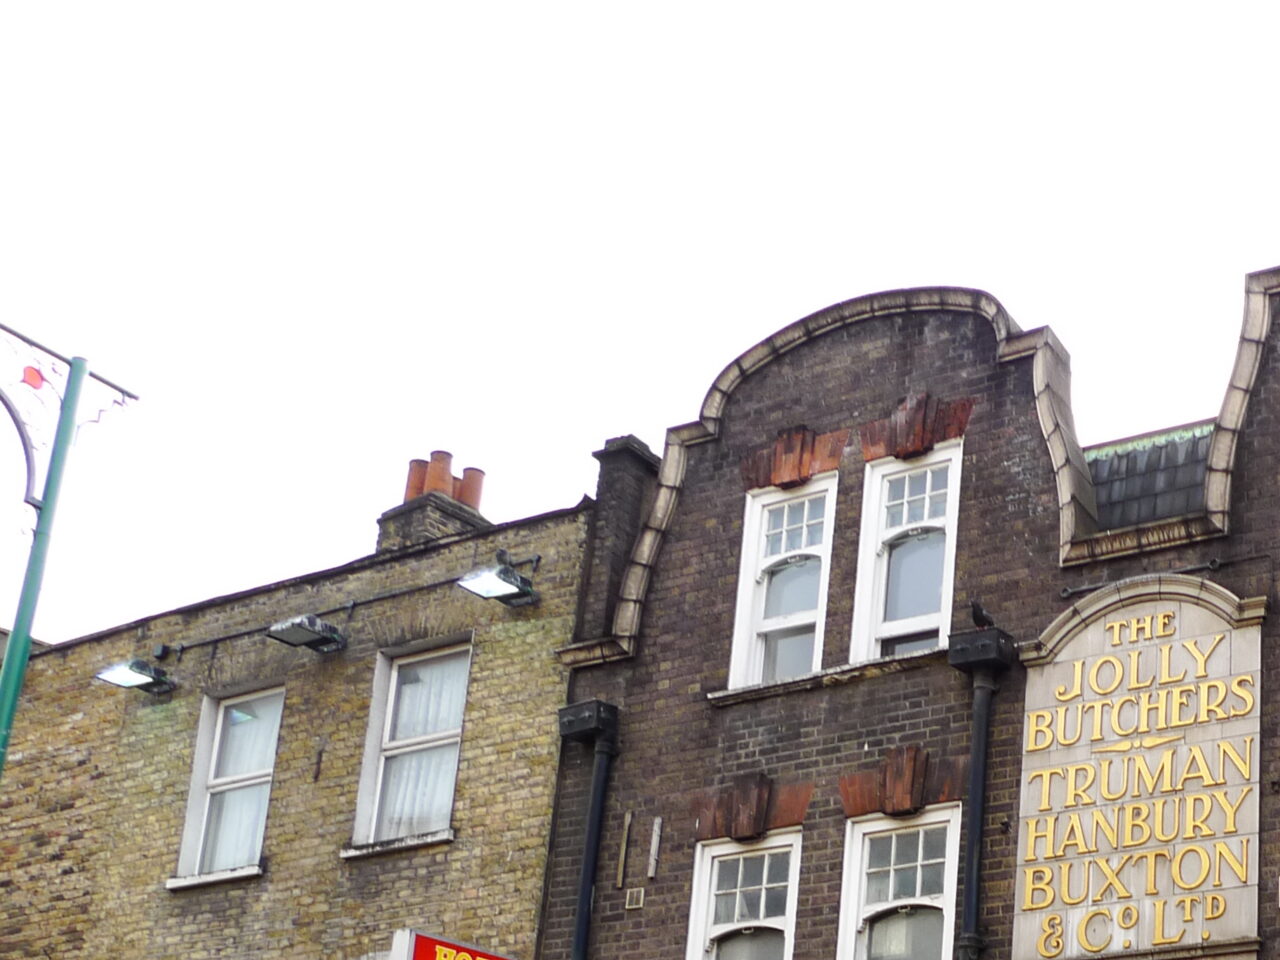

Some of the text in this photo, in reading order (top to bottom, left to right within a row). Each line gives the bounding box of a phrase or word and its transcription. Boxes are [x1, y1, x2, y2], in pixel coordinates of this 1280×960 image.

[1105, 610, 1177, 646] THE
[1055, 633, 1225, 701] JOLLY
[1026, 674, 1255, 753] BUTCHERS
[1028, 736, 1254, 812] TRUMAN
[1024, 786, 1253, 862] HANBURY
[1021, 838, 1249, 911] BUXTON
[1037, 913, 1064, 959] &
